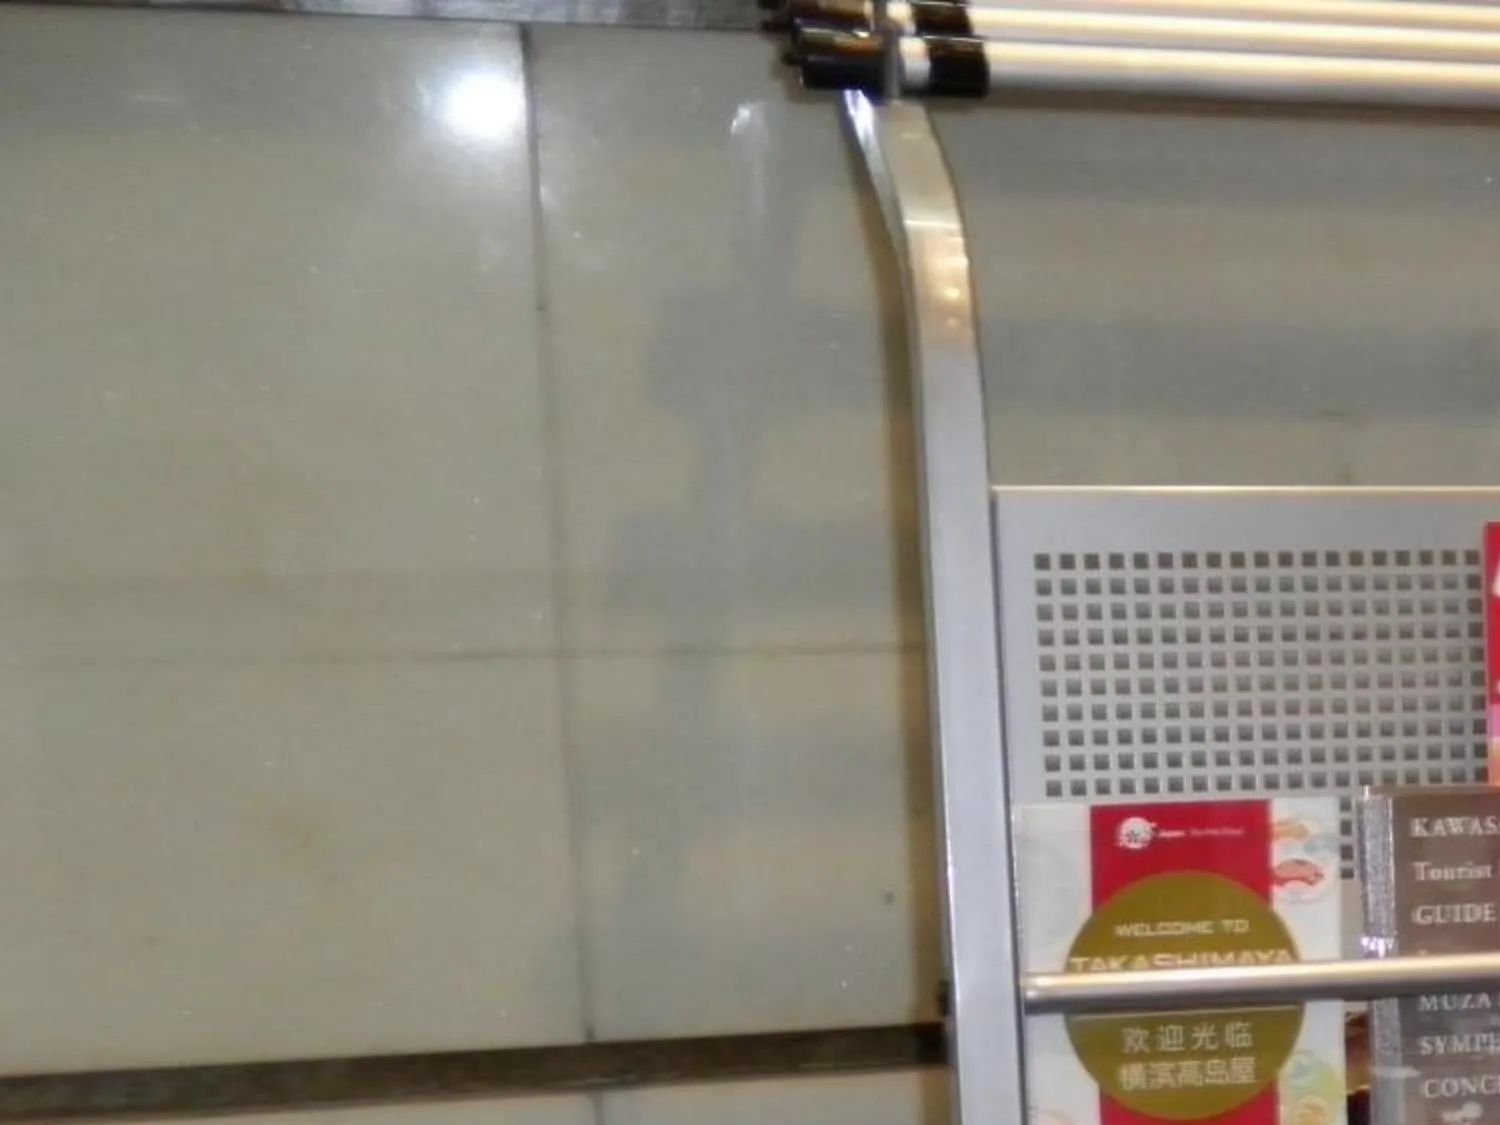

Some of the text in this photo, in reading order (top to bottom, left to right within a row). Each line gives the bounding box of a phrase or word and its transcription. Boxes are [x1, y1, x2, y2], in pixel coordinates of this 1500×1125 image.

[1412, 861, 1495, 882] Tourist
[1412, 904, 1497, 926] GUIDE
[1114, 919, 1251, 938] WELCOME TO
